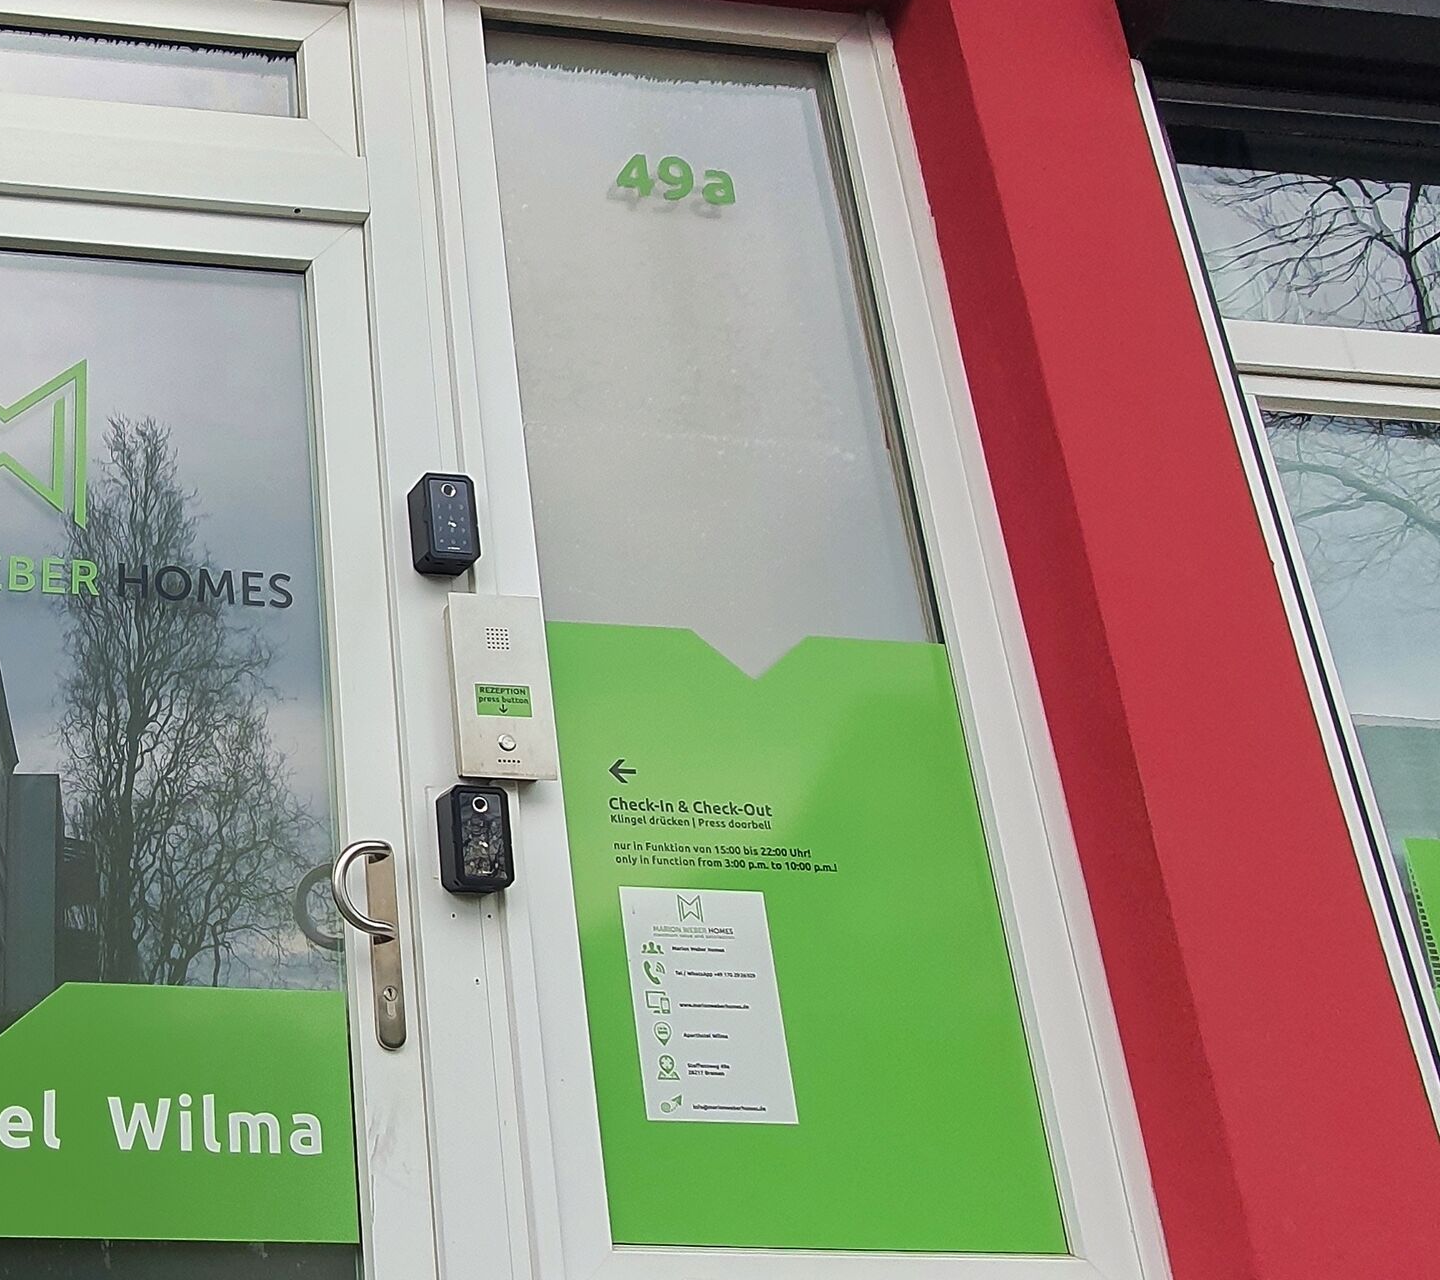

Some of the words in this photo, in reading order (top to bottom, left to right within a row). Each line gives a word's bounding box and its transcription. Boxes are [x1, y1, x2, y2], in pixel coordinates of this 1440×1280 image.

[617, 154, 735, 205] 49a
[118, 562, 293, 609] HOMES
[480, 687, 525, 695] REZEPTION
[502, 696, 528, 704] button
[609, 797, 674, 813] Check-In
[678, 801, 689, 813] &
[694, 801, 772, 817] Check-Out
[610, 815, 647, 826] Klingel
[649, 815, 690, 827] drücken
[698, 819, 726, 828] Press
[729, 819, 771, 830] doorbell
[614, 842, 631, 850] nur
[633, 841, 643, 851] in
[645, 842, 691, 853] Funktion
[693, 846, 711, 854] von
[715, 846, 741, 855] 15:00
[744, 846, 758, 856] bis
[760, 847, 787, 857] 22:00
[790, 848, 811, 858] Uhr!
[615, 855, 637, 866] only
[640, 855, 650, 864] in
[652, 856, 695, 867] function
[697, 858, 722, 867] from
[725, 859, 745, 868] 3:00
[771, 861, 782, 870] to
[785, 862, 811, 871] 10:00
[108, 1094, 322, 1155] Wilma
